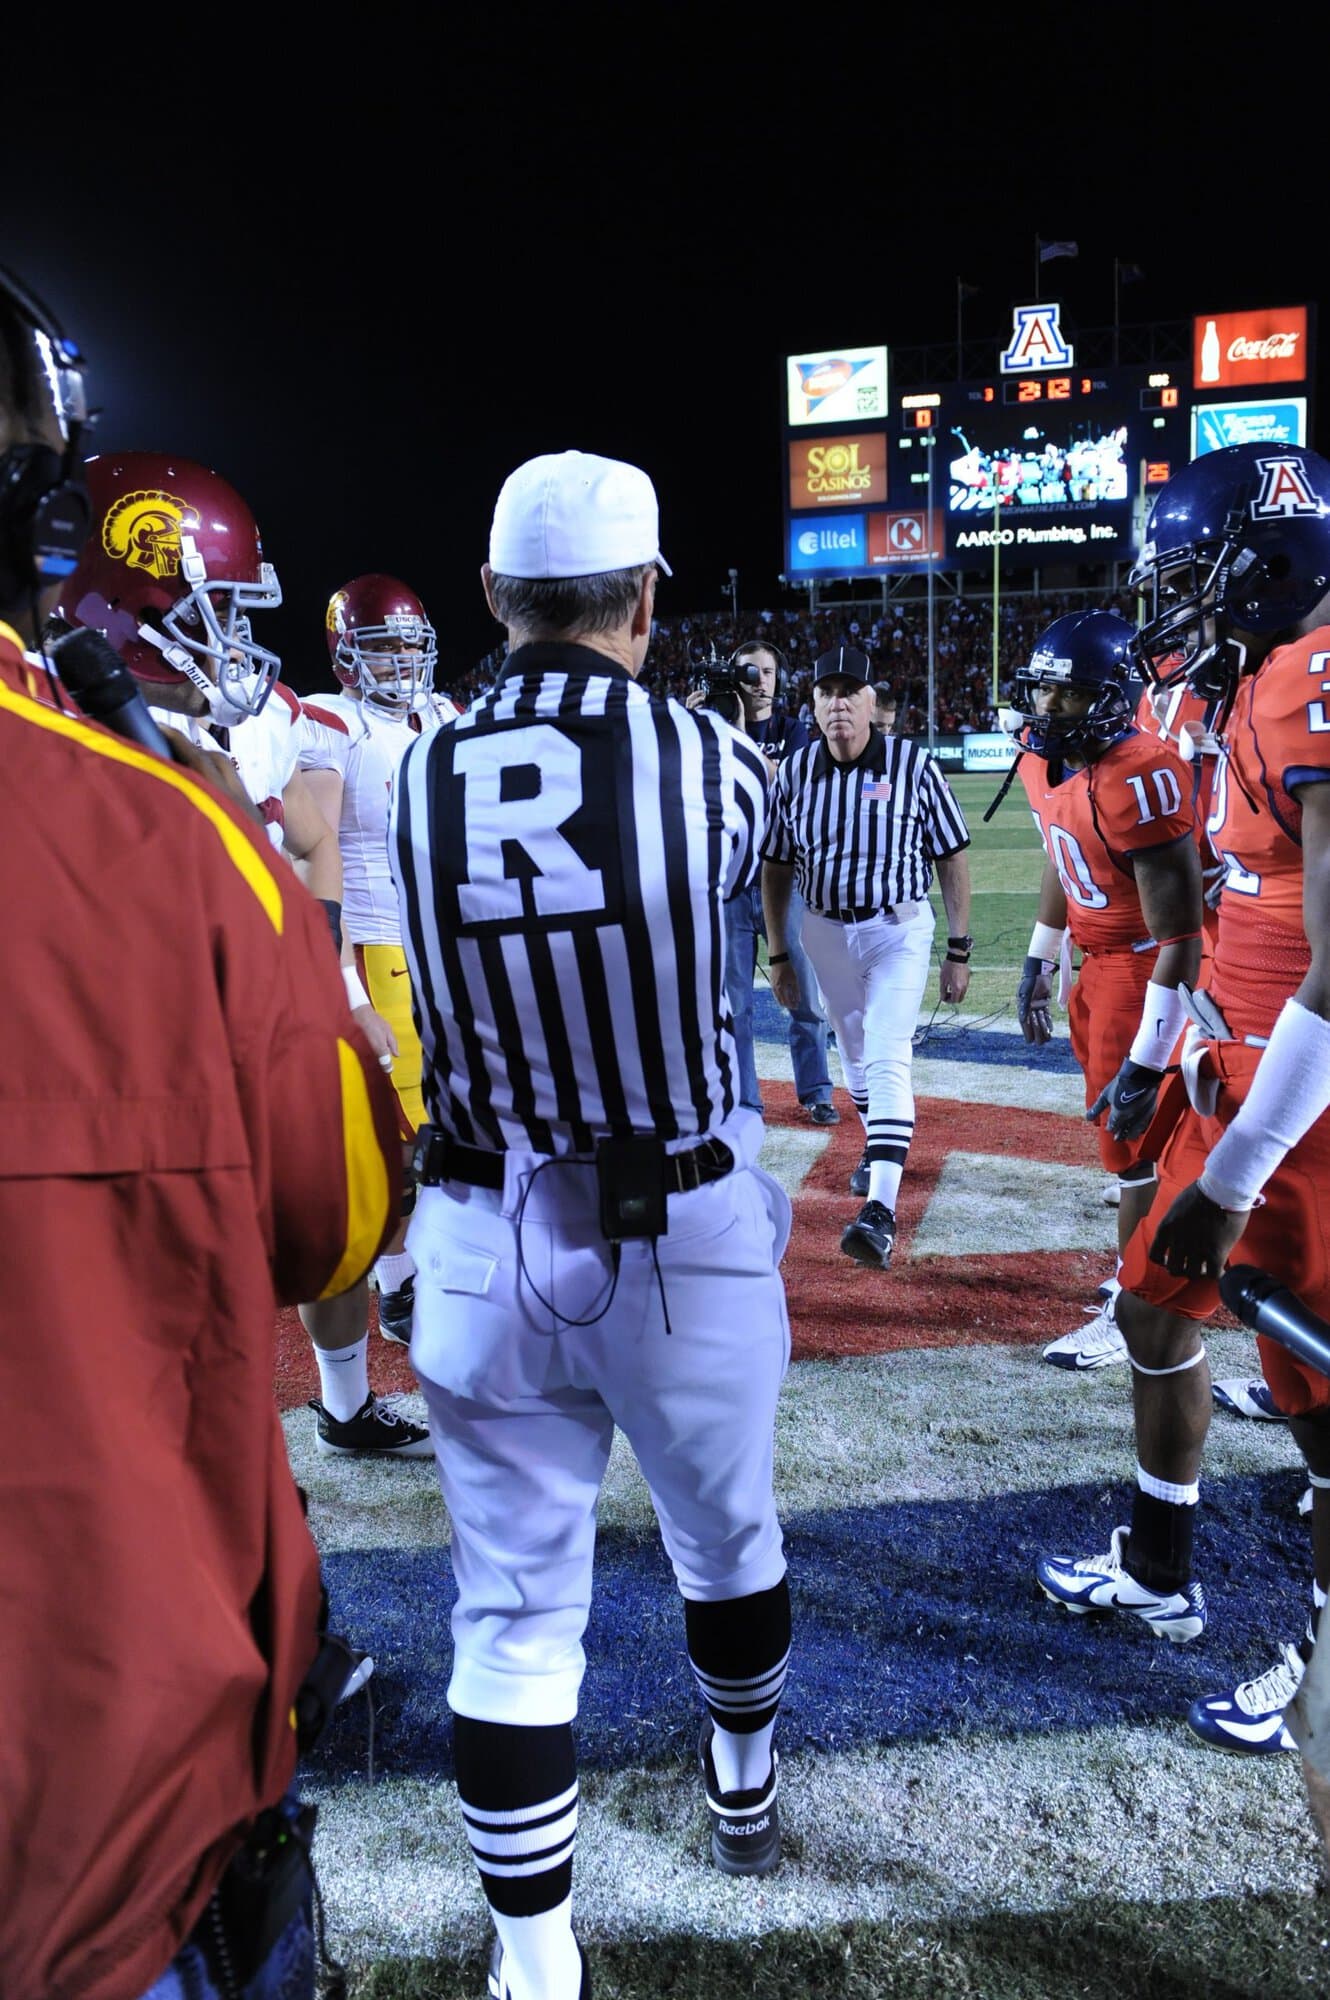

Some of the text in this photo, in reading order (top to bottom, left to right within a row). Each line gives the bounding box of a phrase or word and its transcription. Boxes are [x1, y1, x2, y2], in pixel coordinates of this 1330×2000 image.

[1000, 303, 1073, 373] A
[808, 443, 871, 478] SOL
[807, 473, 871, 492] CASINOS
[1251, 455, 1327, 520] A
[956, 529, 1014, 547] AARCO
[1089, 523, 1118, 539] Inc.
[967, 748, 1003, 758] MUSCLE
[1126, 767, 1182, 826] 10
[452, 724, 605, 924] R
[719, 1815, 770, 1836] Reebok
